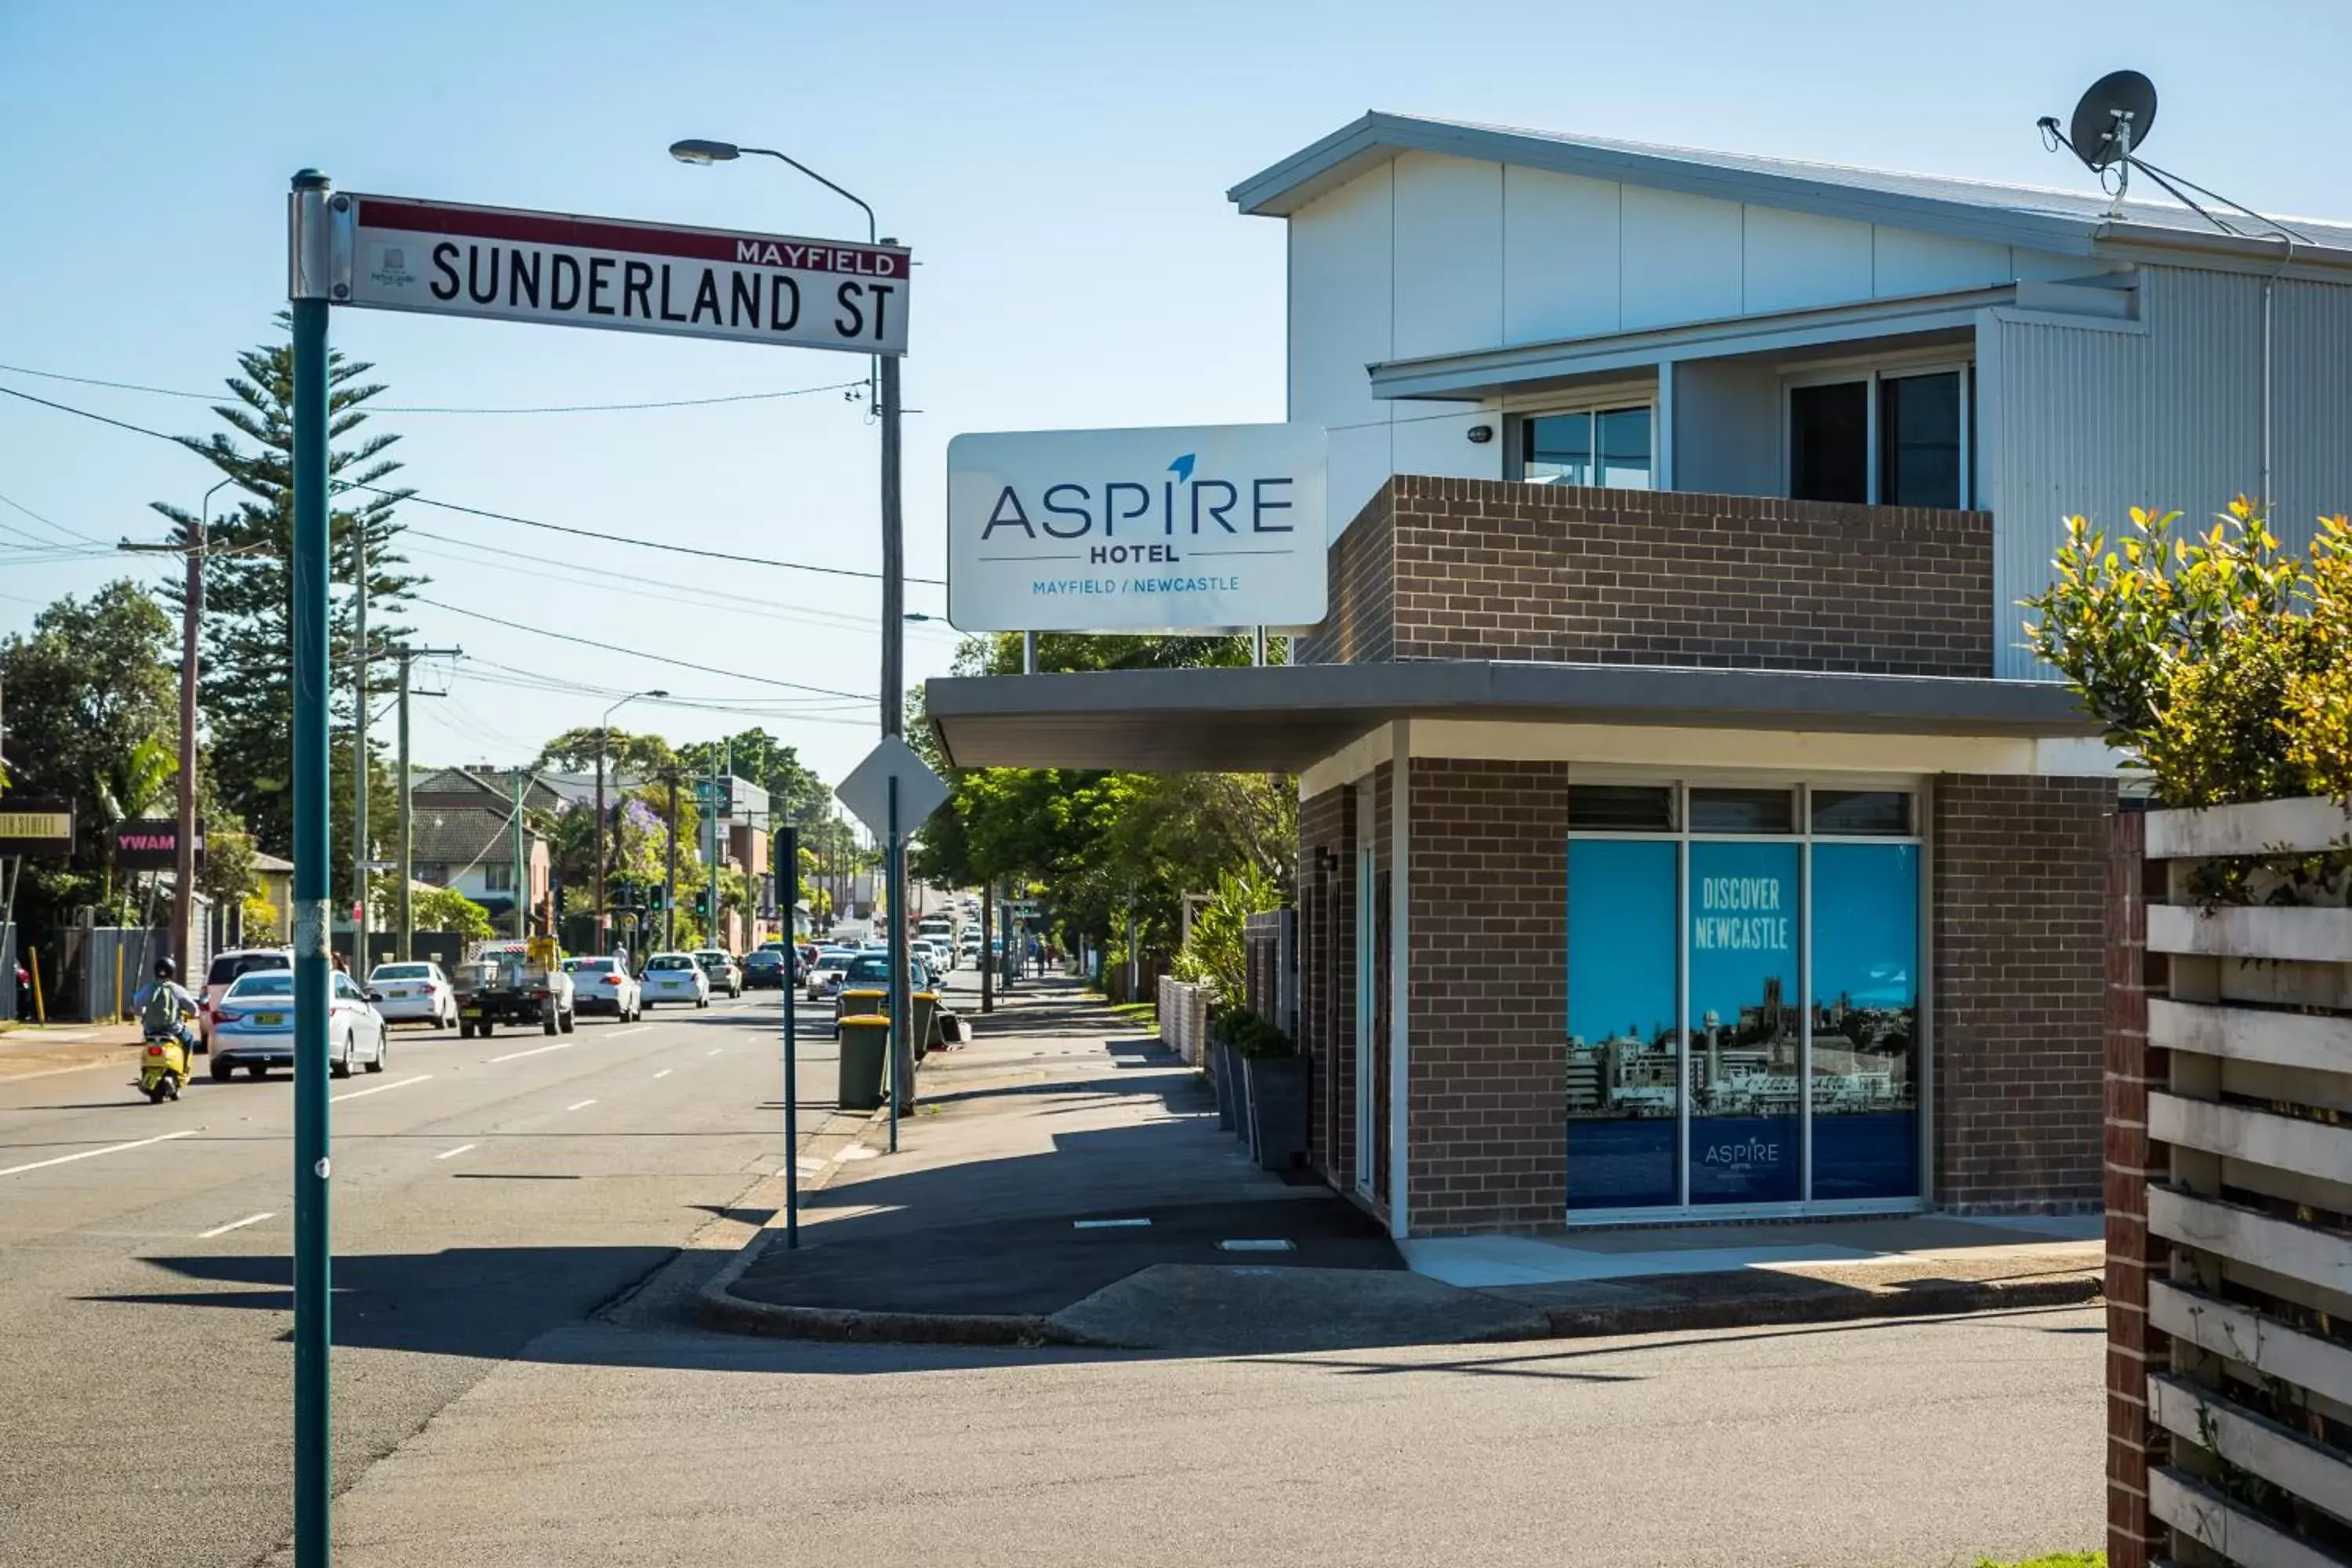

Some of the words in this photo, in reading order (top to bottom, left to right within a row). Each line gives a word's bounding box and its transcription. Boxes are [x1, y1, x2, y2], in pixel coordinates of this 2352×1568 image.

[737, 240, 895, 275] MAYFIELD
[430, 242, 800, 331] SUNDERLAND
[835, 281, 893, 340] ST
[981, 477, 1294, 540] ASPIRE
[1091, 545, 1180, 564] HOTEL
[1033, 579, 1116, 594] MAYFIELD
[1134, 576, 1239, 593] NEWCASTLE
[118, 835, 175, 851] YWAM
[1704, 877, 1780, 910] DISCOVER
[1695, 916, 1788, 949] NEWCASTLE
[1705, 1144, 1780, 1163] ASPIRE
